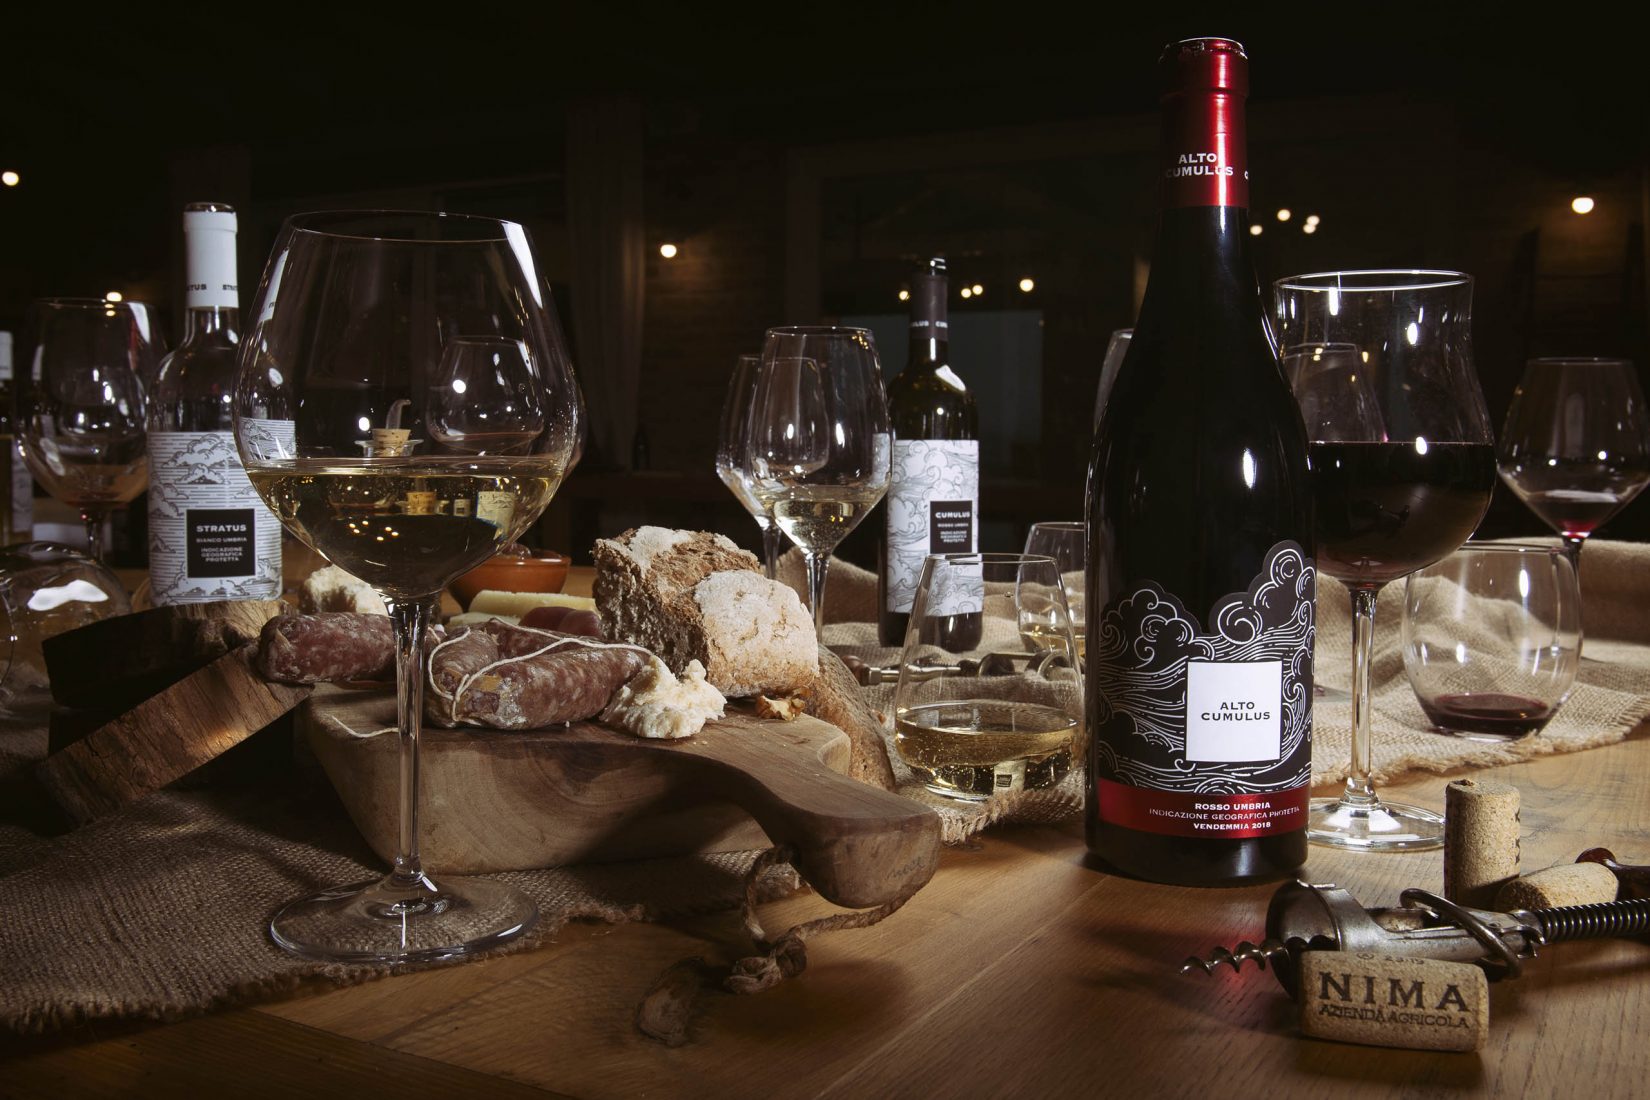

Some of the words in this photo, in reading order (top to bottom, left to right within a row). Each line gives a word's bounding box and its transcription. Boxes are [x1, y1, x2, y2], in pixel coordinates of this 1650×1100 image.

[1178, 153, 1217, 164] ALTO
[1166, 166, 1234, 178] CUMULUS
[935, 511, 971, 519] CUMULUS
[196, 524, 247, 533] STRATUS
[1220, 701, 1256, 711] ALTO
[1201, 711, 1271, 721] CUMULUS
[1194, 803, 1231, 811] ROSSO
[1233, 802, 1271, 811] UMBRIA
[1149, 808, 1209, 821] INDICAZIONE
[1211, 811, 1268, 821] GEOGRAFICA
[1193, 822, 1250, 831] VENDEMMIA
[1251, 822, 1272, 830] 2018
[1318, 971, 1472, 1012] NIMA
[1319, 1004, 1386, 1024] AZIENDA
[1389, 1012, 1470, 1029] AGRICOLA
